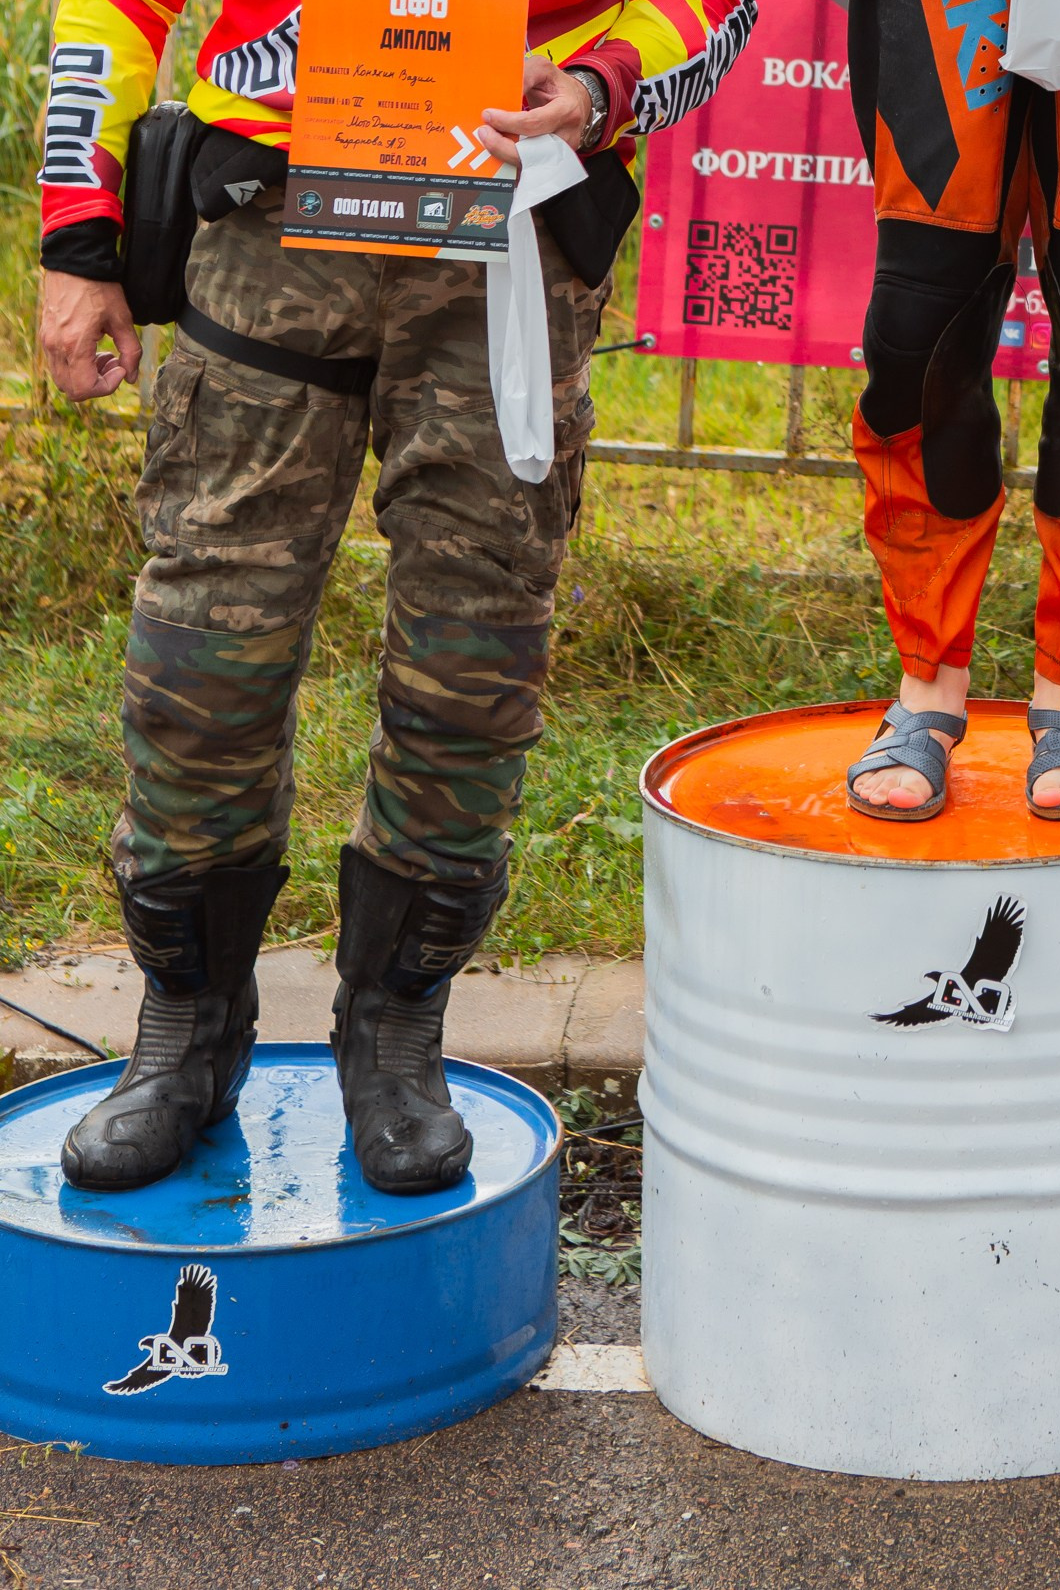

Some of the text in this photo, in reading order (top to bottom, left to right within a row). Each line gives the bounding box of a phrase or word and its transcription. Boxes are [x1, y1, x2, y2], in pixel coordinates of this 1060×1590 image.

[380, 28, 452, 52] ДИПЛОМ
[309, 65, 350, 76] НАГРАЖДАЕТСЯ
[762, 57, 851, 91] ВОКА
[378, 100, 394, 109] МЕСТО
[400, 101, 420, 110] КЛАССЕ
[304, 117, 344, 125] ОРГАНИЗАТОР
[405, 155, 427, 167] 2024
[691, 147, 875, 186] ФОРТЕПИ
[362, 199, 379, 218] ТД
[380, 201, 405, 219] ИТА
